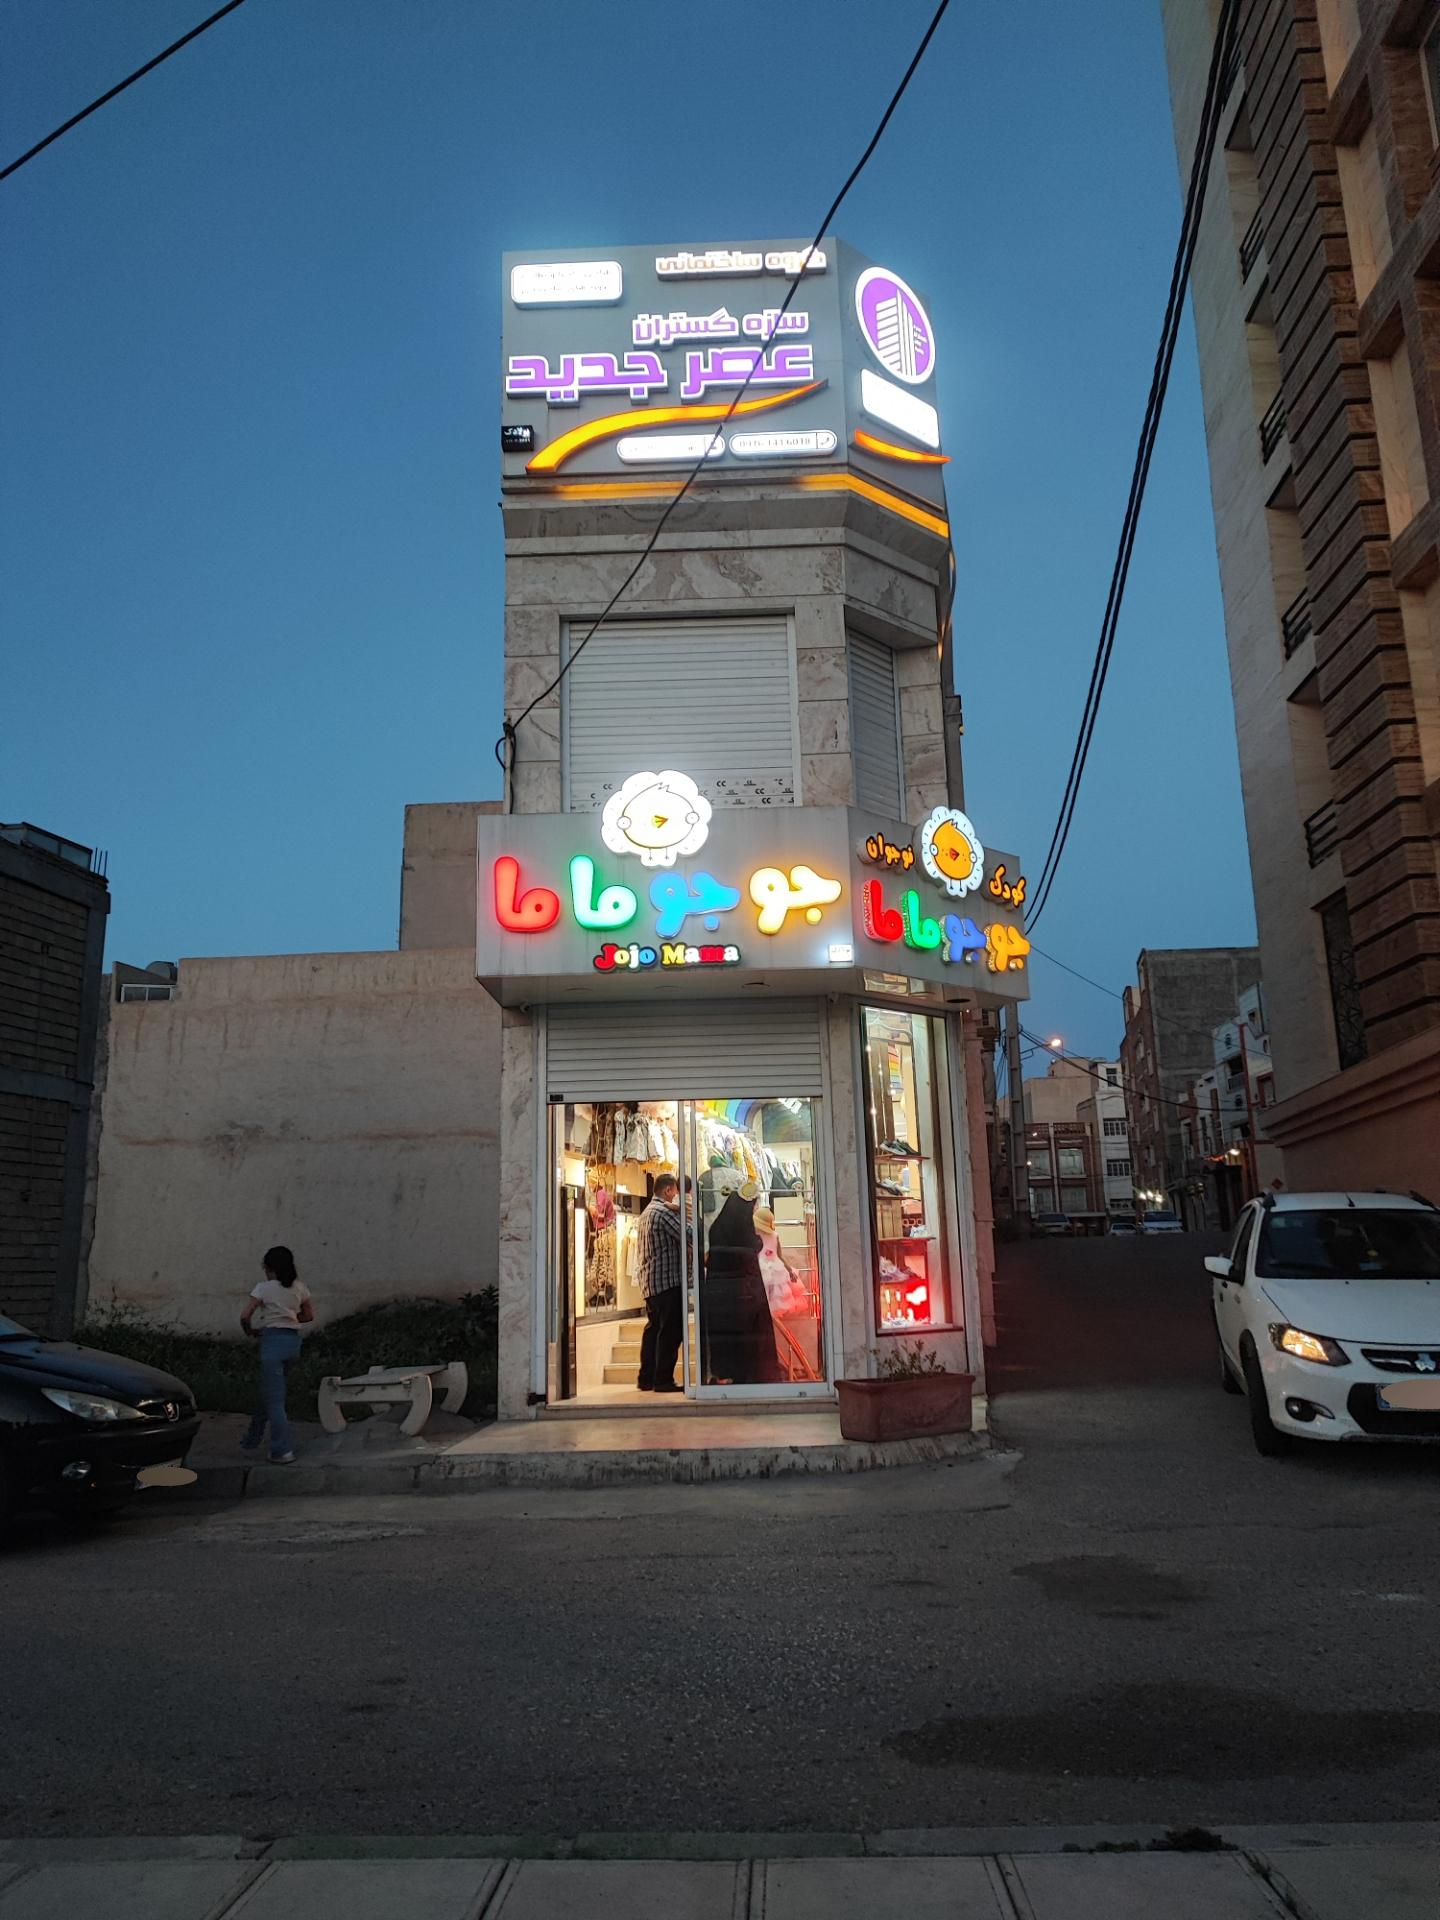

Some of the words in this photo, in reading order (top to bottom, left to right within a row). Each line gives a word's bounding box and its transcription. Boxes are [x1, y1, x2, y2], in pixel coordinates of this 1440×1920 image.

[656, 251, 762, 274] ساختمانی
[633, 306, 739, 345] گستران
[742, 308, 809, 341] سازه
[506, 351, 668, 402] جدید
[681, 345, 814, 397] عصر
[866, 832, 915, 871] نوجوان
[989, 864, 1026, 908] کودک
[595, 943, 657, 972] Jojo
[661, 943, 740, 967] Mama
